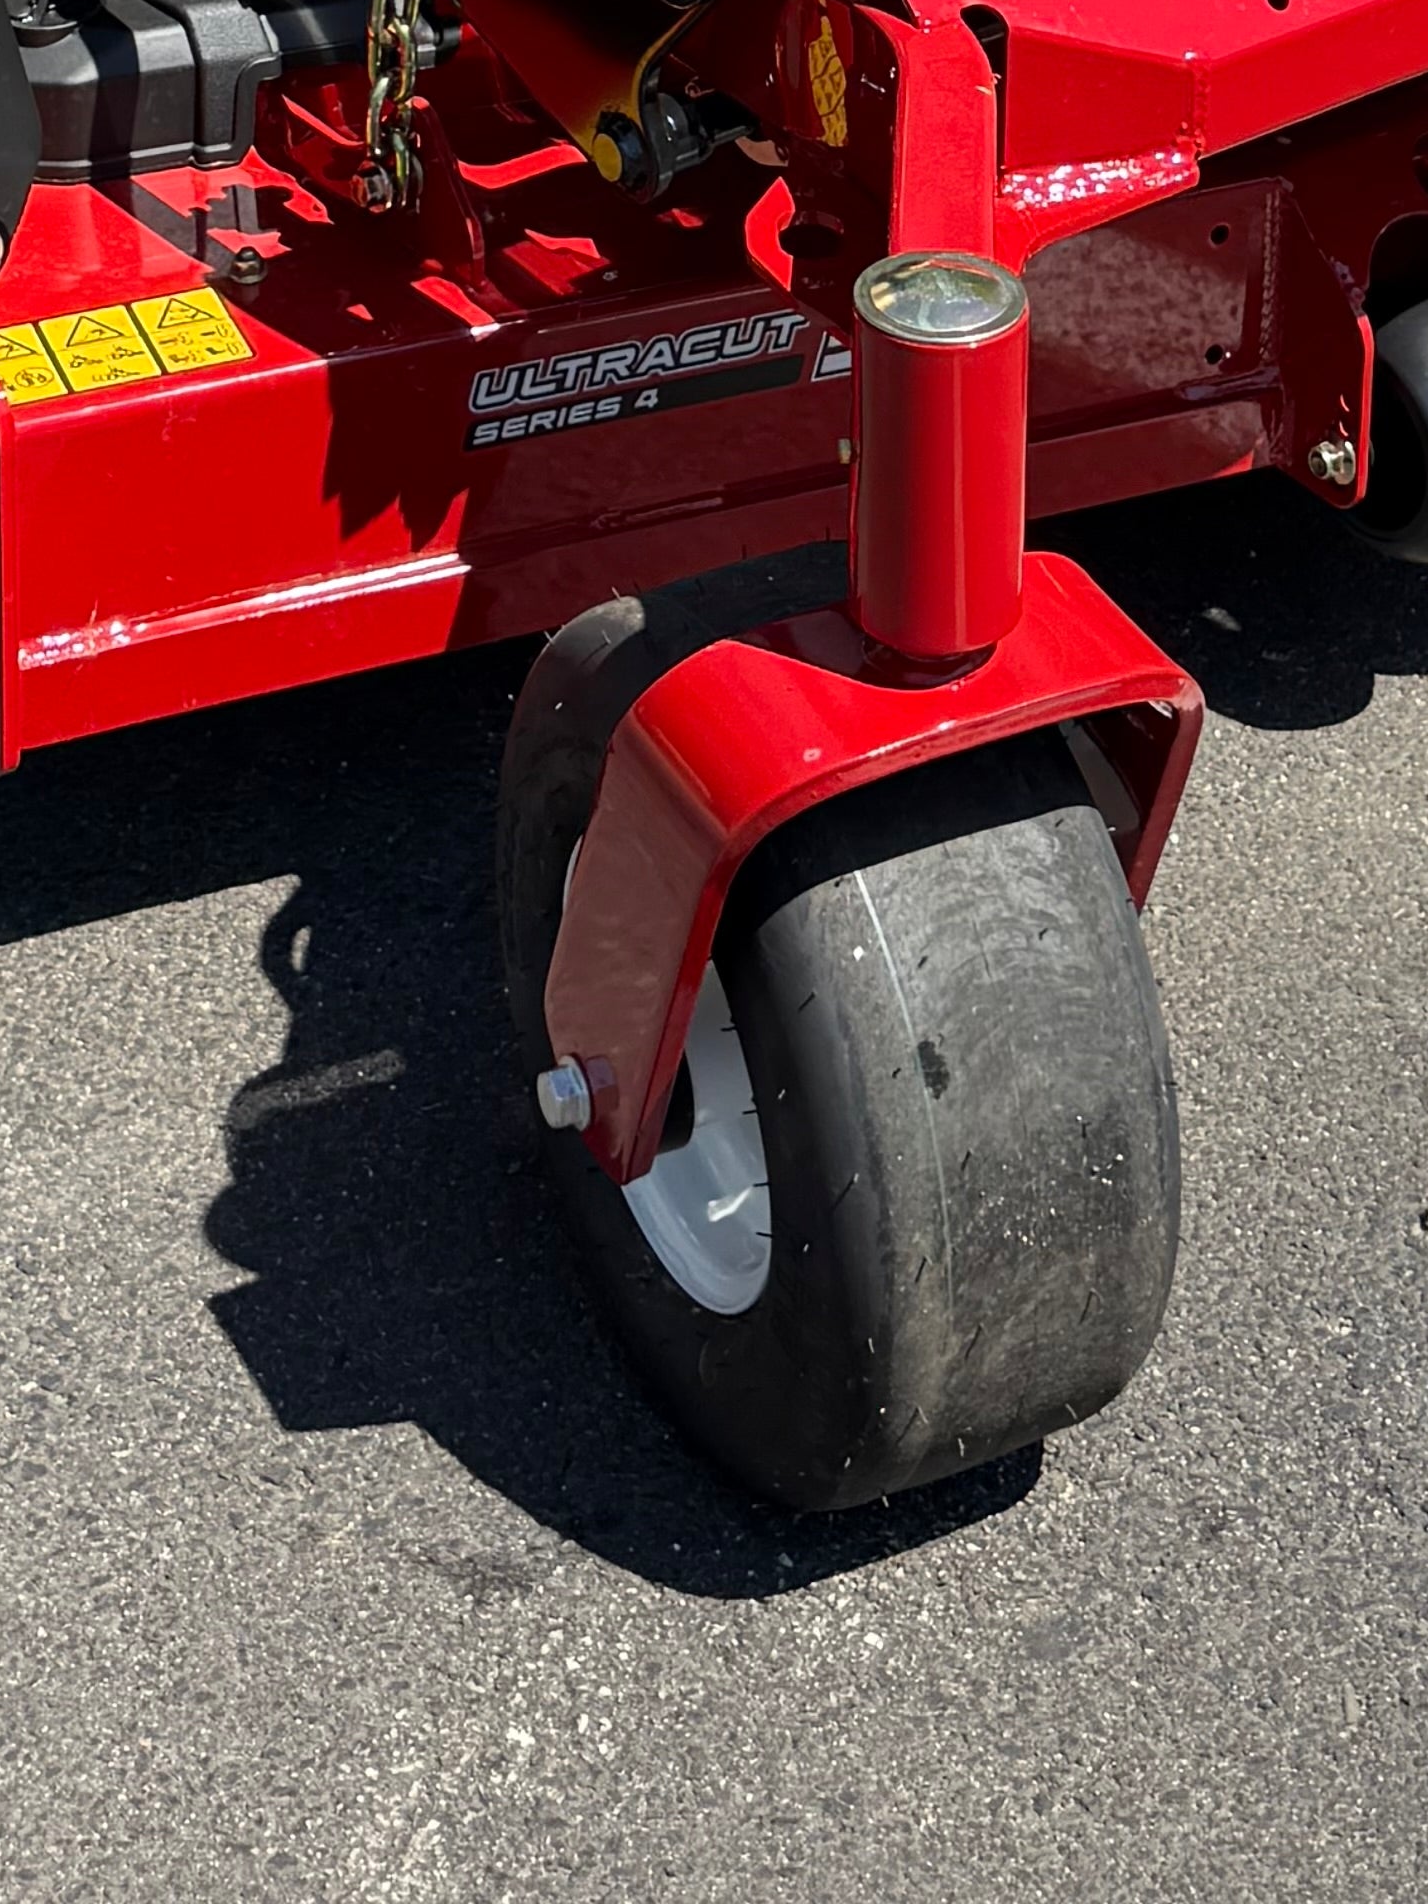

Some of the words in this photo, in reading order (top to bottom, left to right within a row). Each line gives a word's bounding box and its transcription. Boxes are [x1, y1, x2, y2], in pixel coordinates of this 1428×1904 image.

[469, 311, 810, 414] ULTRACUT
[471, 394, 622, 446] SERIES
[633, 387, 659, 411] 4
